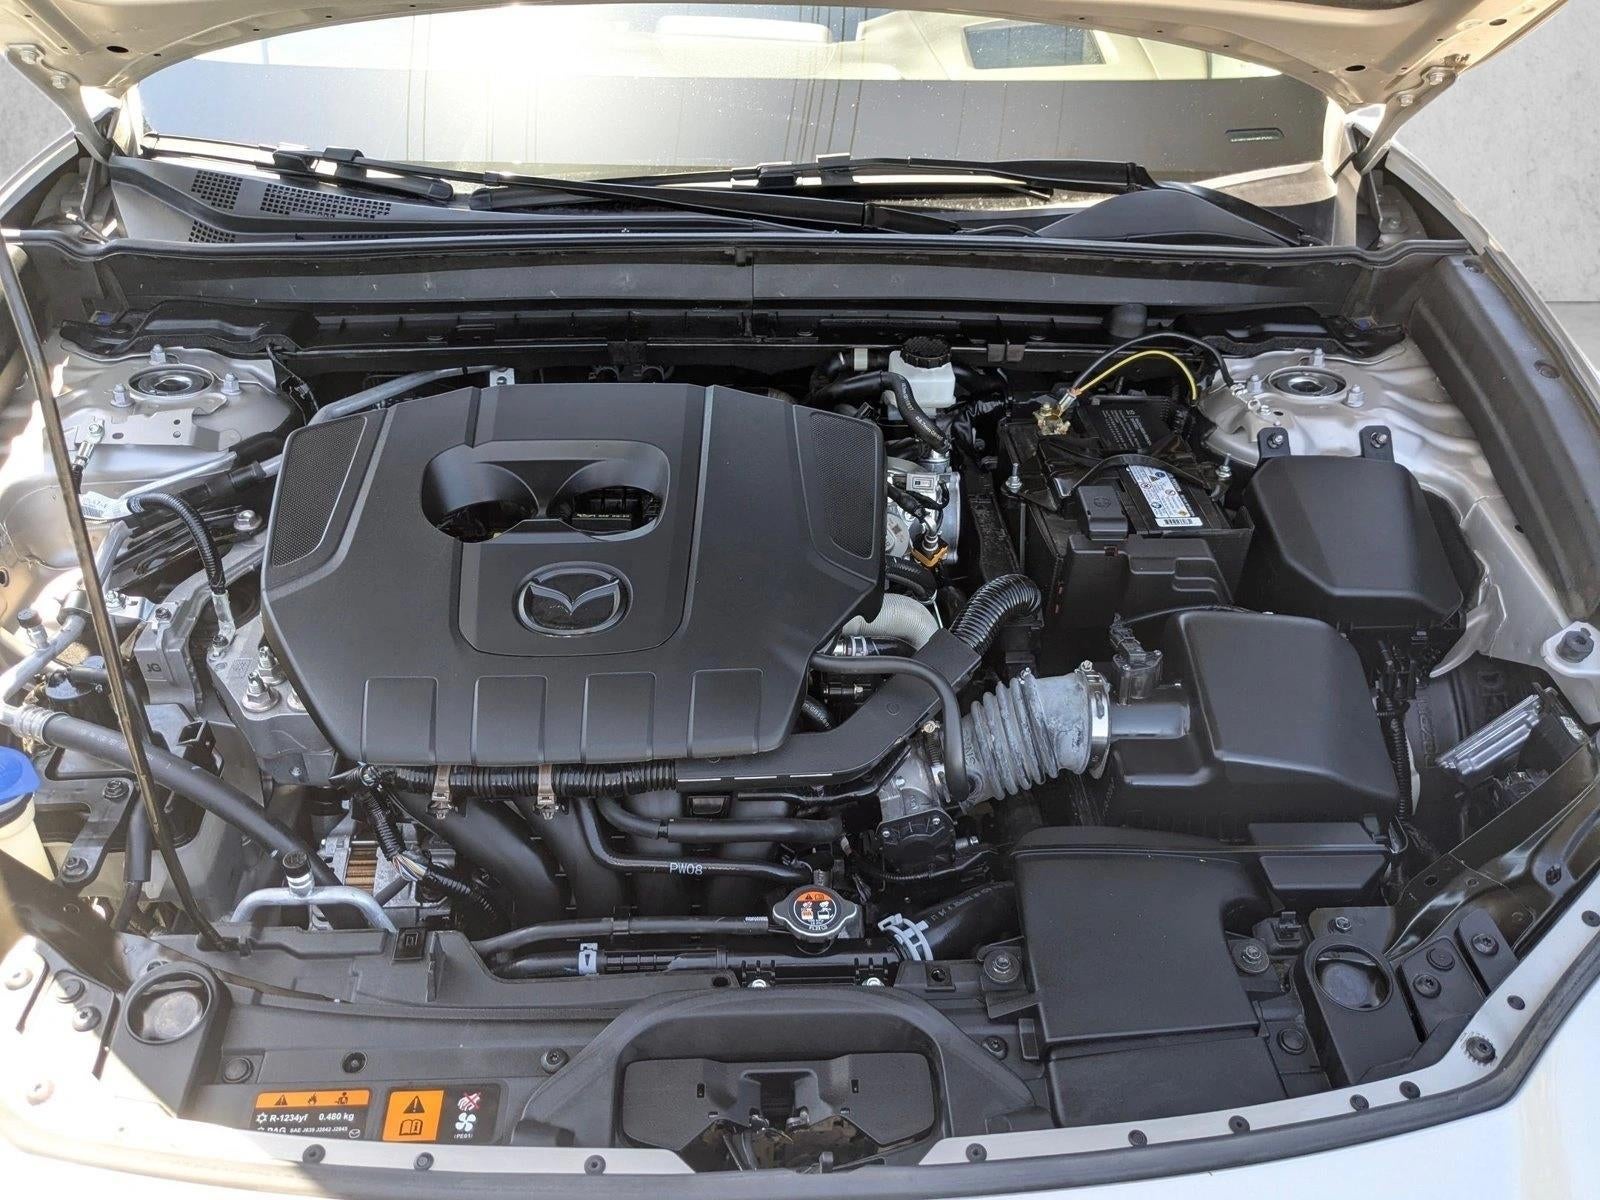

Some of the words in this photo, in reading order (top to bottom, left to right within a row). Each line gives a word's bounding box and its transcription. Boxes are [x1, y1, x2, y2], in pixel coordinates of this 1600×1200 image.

[669, 862, 703, 875] PW08
[269, 1114, 309, 1123] R-1234yf
[343, 1112, 355, 1122] kg
